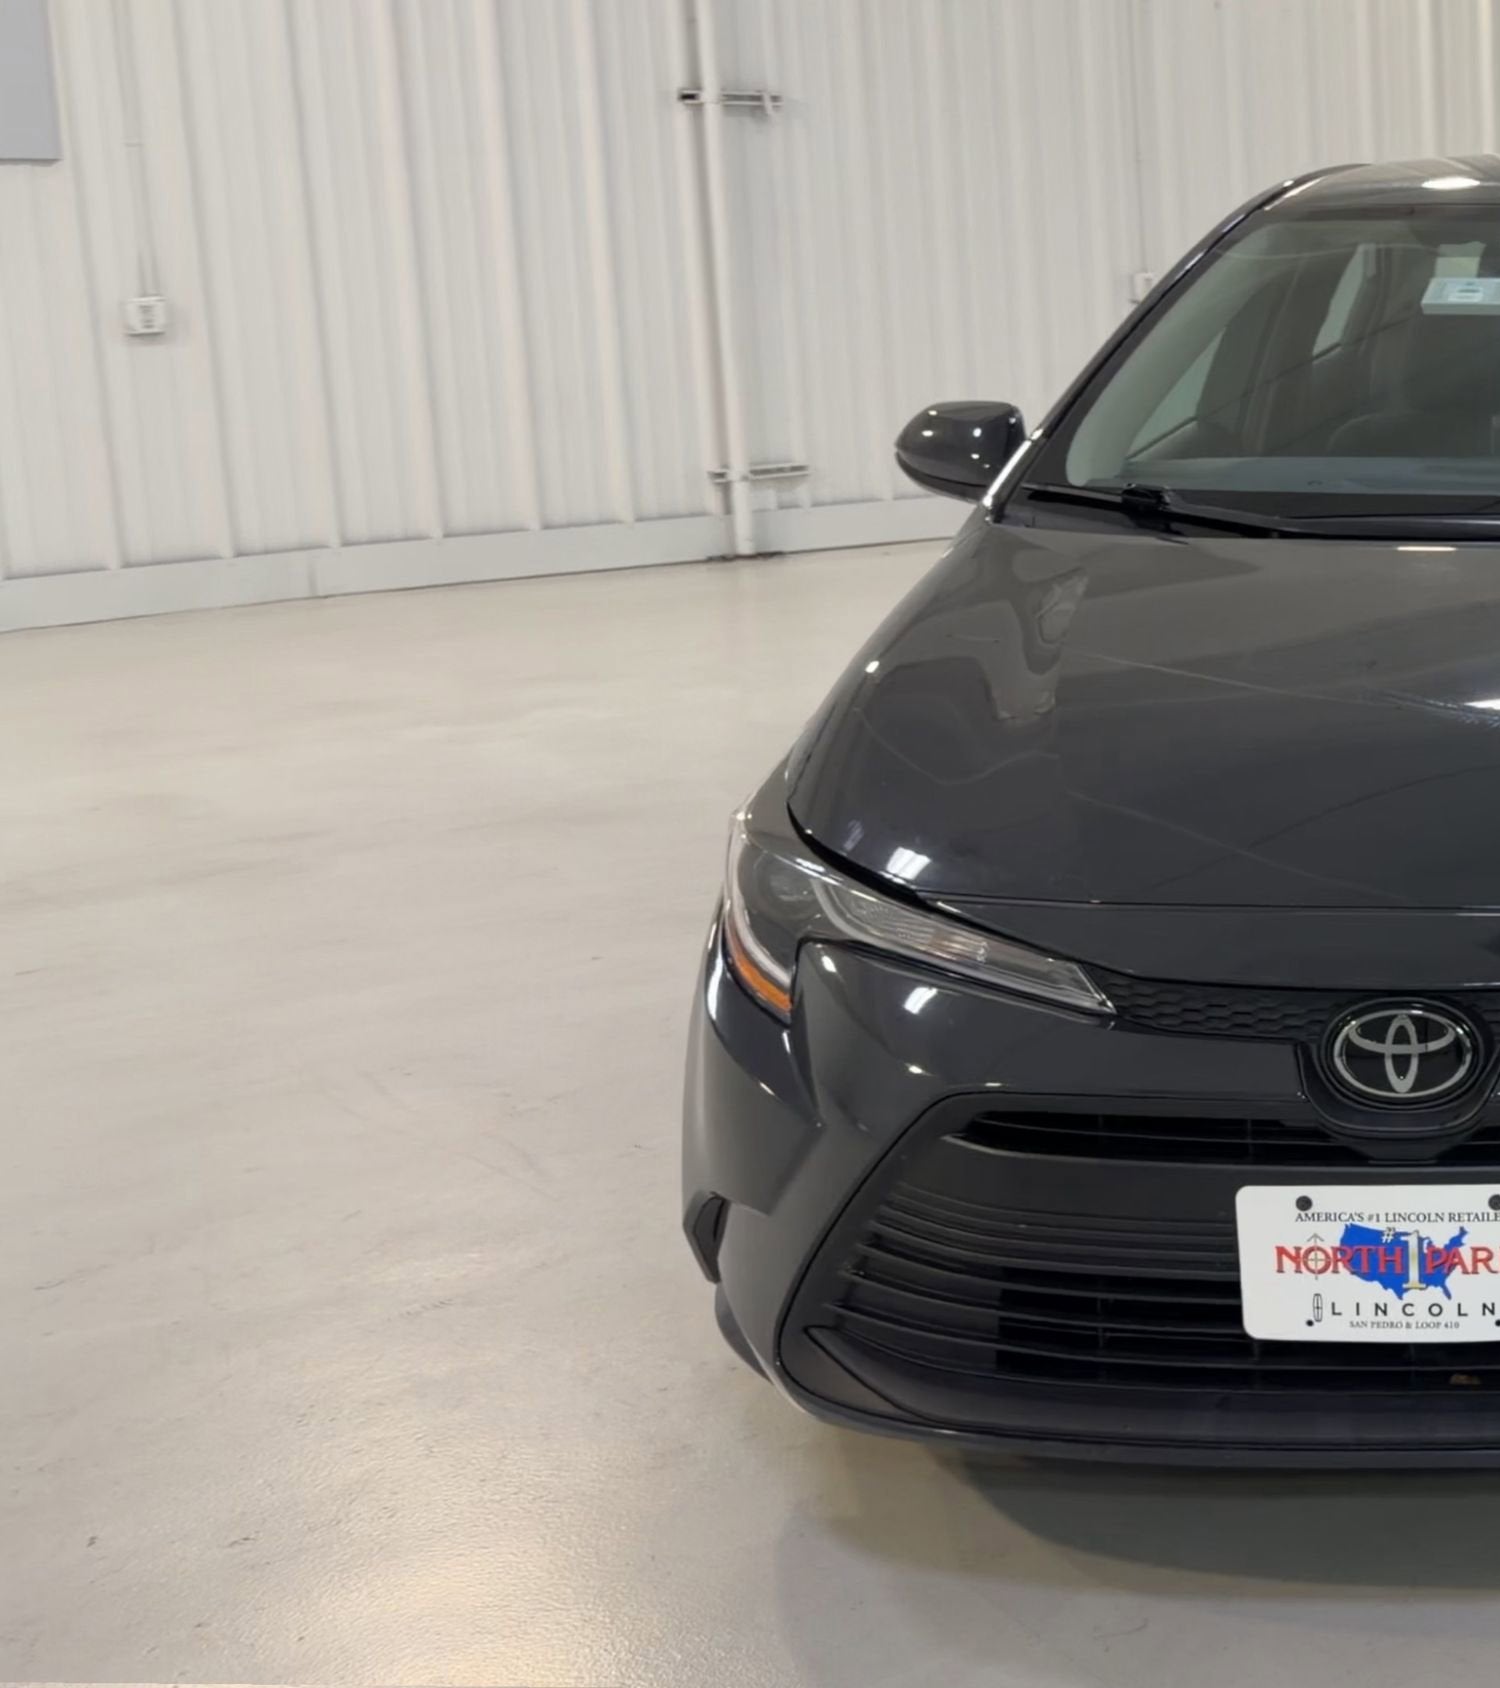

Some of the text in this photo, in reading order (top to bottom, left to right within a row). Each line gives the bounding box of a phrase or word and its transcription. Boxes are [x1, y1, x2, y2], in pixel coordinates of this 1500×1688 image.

[1295, 1211, 1364, 1222] AMERICA'S
[1367, 1212, 1381, 1223] #1
[1384, 1211, 1445, 1223] LINCOLN
[1275, 1245, 1405, 1274] NORTH
[1330, 1302, 1496, 1317] LINCOLN
[1349, 1319, 1460, 1330] SAN PEDRO & LOOP 410
